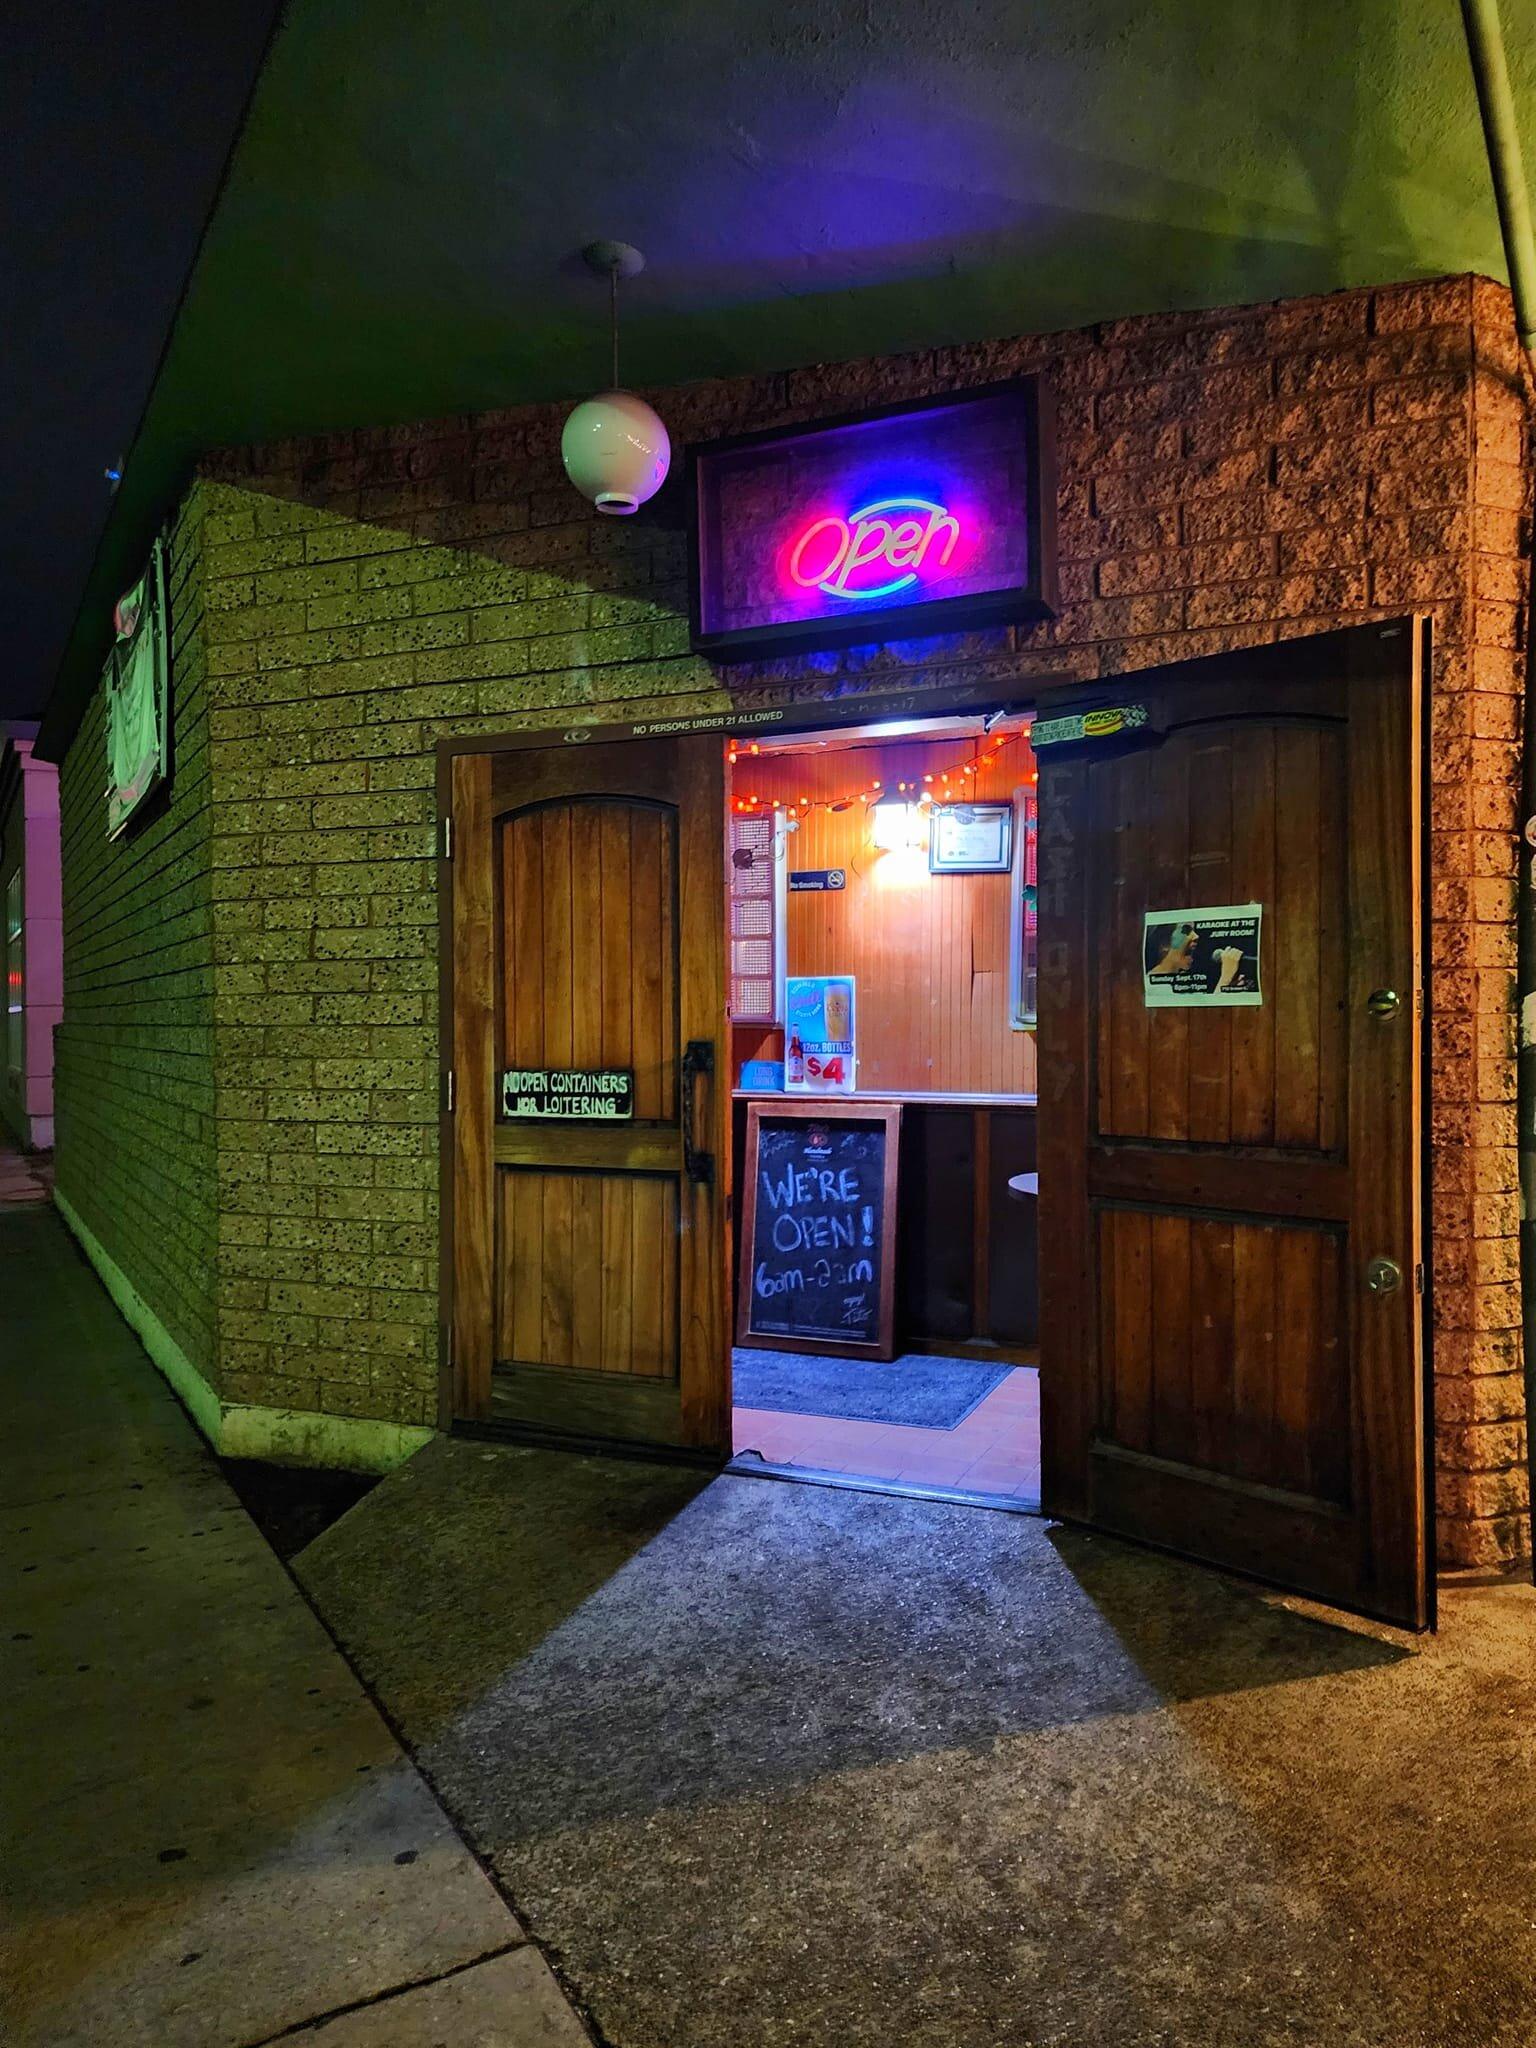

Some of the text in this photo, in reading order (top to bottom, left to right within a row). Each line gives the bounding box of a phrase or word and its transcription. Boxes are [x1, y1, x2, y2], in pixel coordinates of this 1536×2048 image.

[790, 511, 960, 590] Open
[633, 711, 784, 735] NO PERSONS UNDER 21 ALLOWED
[1196, 921, 1230, 929] KARAOKE
[1151, 975, 1174, 983] Sunday
[1175, 974, 1192, 982] Sept.
[822, 1042, 851, 1053] BOTTLES
[807, 1056, 845, 1085] $4
[520, 1072, 548, 1093] OPEN
[550, 1072, 628, 1094] CONTAINERS
[544, 1095, 616, 1114] LOITERING
[762, 1163, 861, 1209] WE'RE
